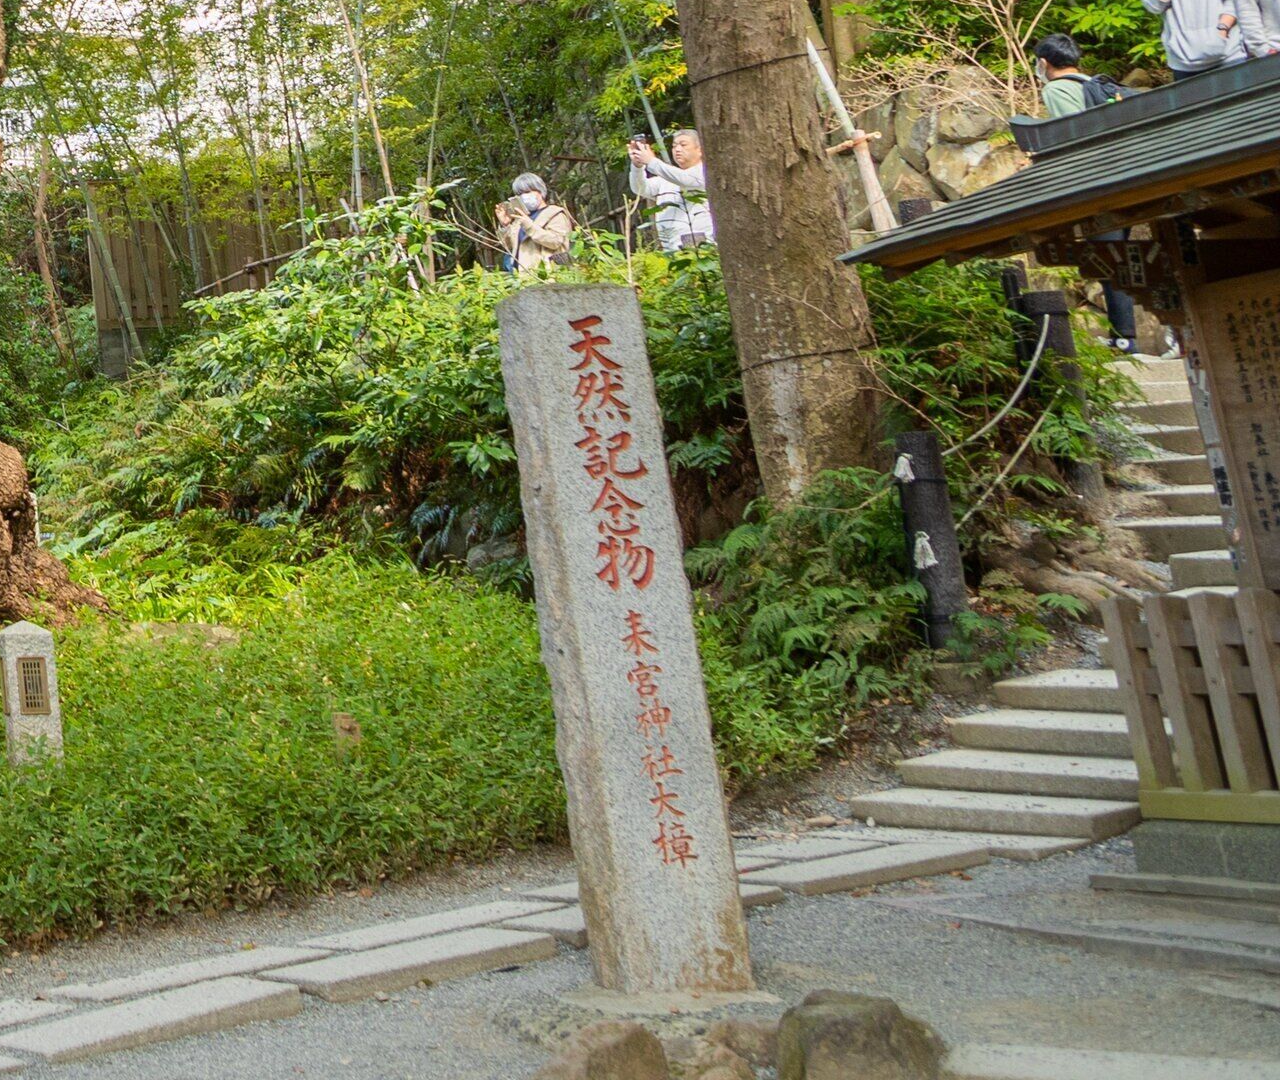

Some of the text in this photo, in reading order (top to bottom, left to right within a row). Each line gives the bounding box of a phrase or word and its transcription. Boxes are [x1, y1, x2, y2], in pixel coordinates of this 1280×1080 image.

[567, 314, 655, 592] 天然記念物
